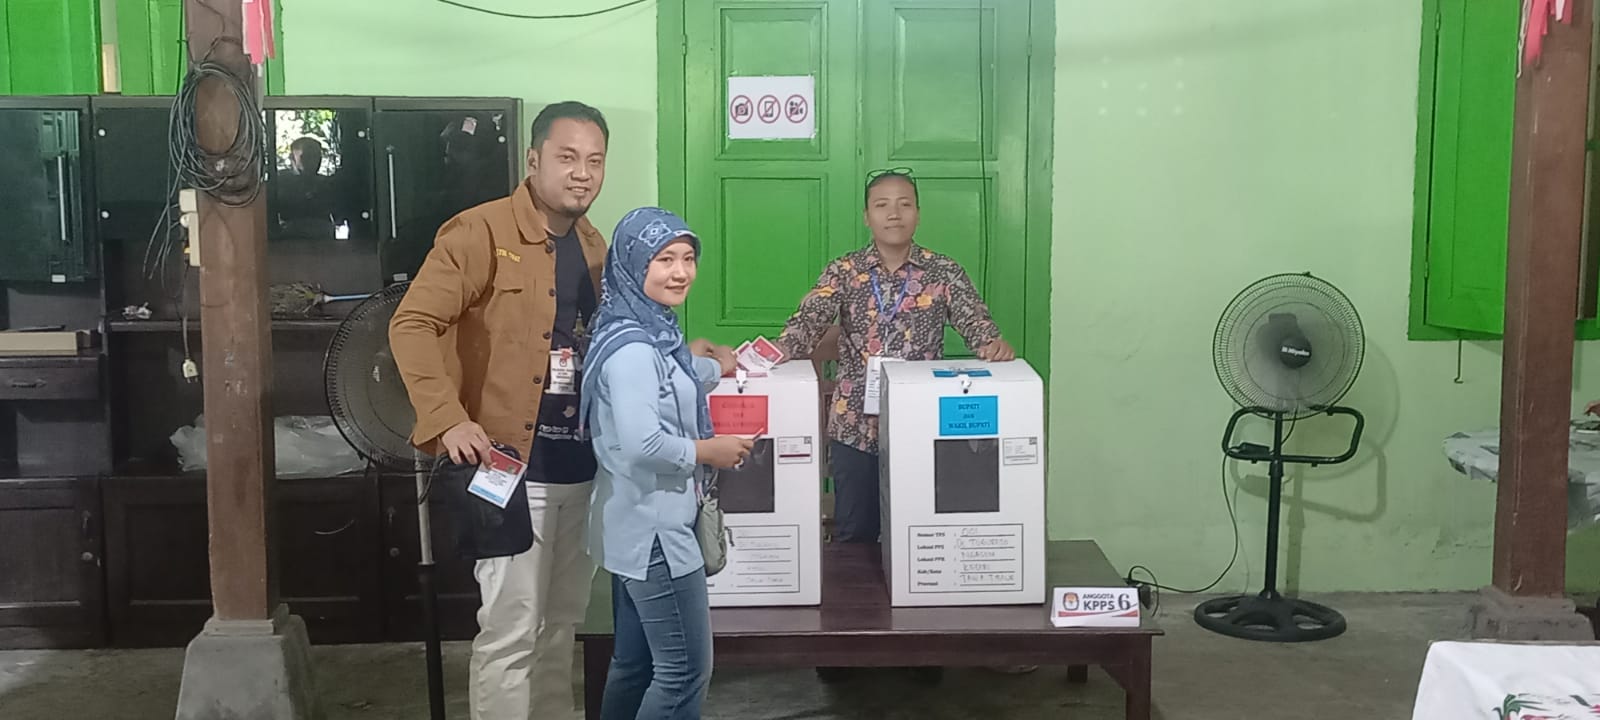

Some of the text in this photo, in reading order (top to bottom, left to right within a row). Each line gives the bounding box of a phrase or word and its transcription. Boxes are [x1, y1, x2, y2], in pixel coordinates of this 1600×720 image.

[968, 421, 991, 429] BUPATI
[1083, 593, 1131, 611] KPPS 6
